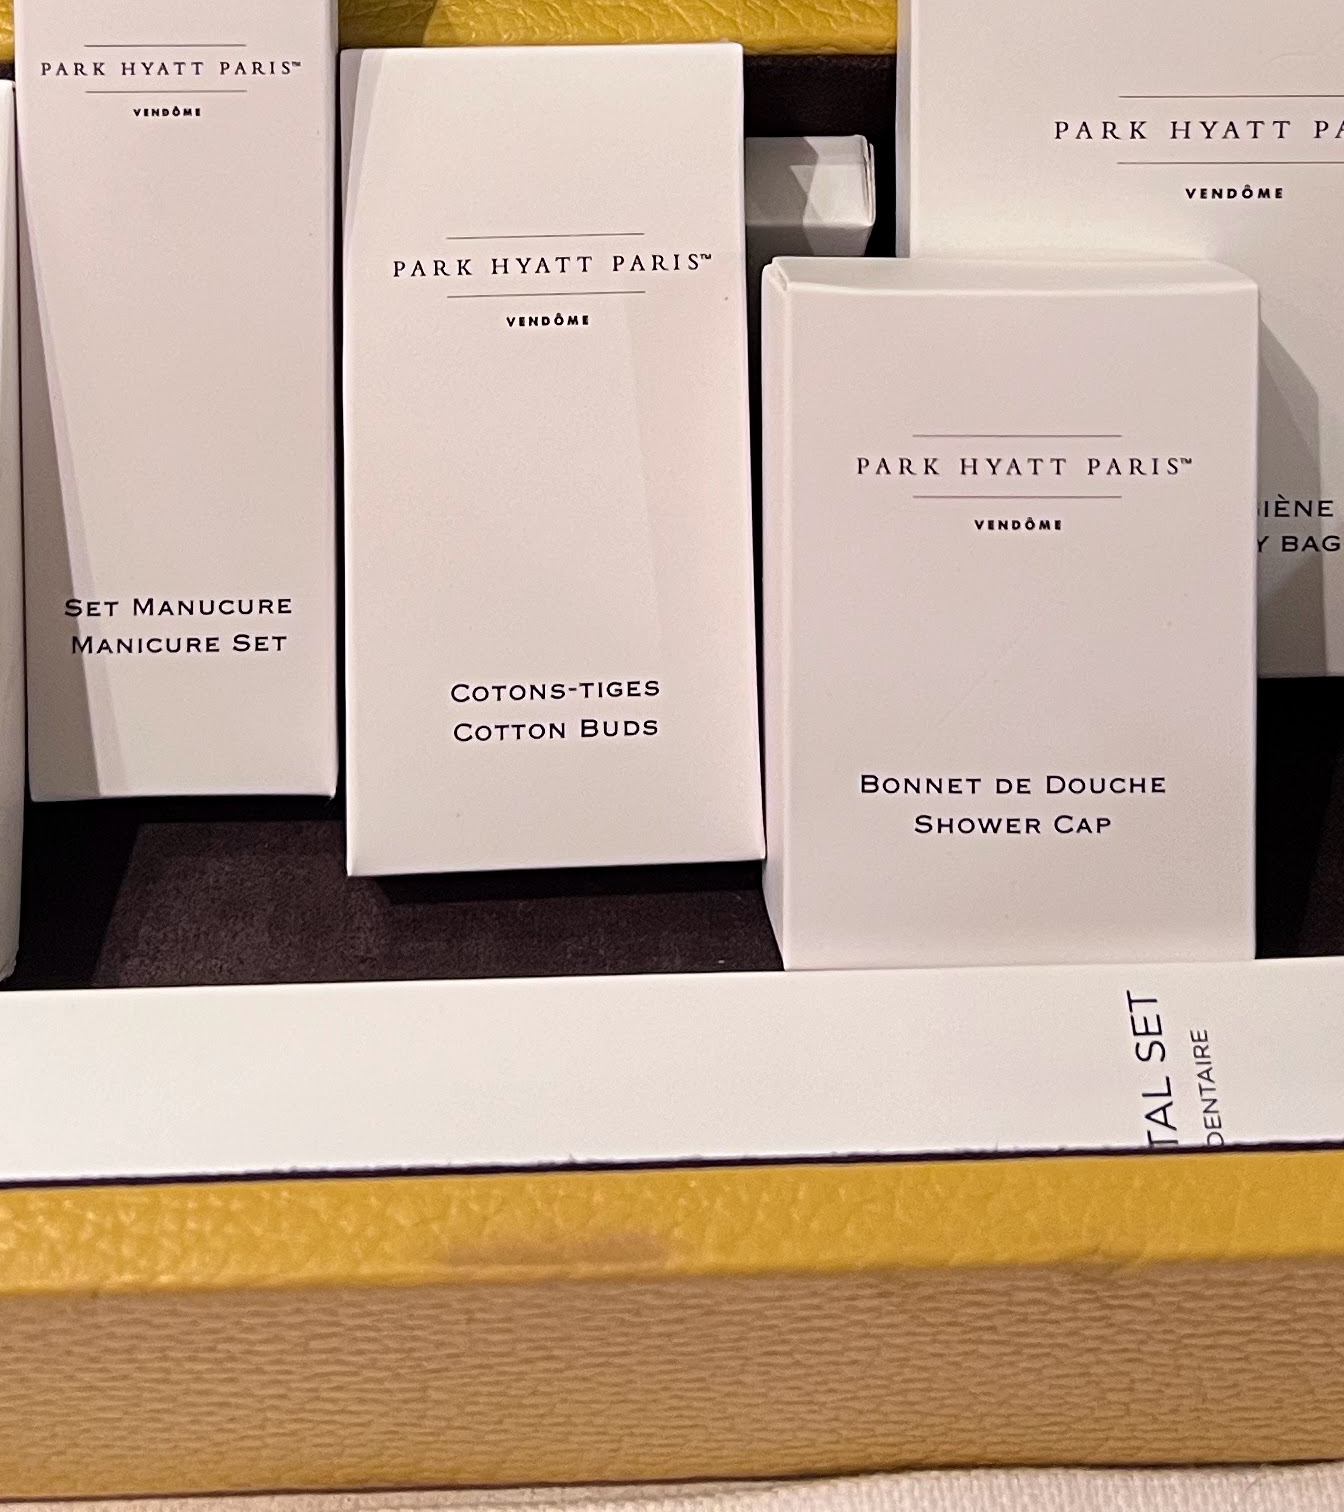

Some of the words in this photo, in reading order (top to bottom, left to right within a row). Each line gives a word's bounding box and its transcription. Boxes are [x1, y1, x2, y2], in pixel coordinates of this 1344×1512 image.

[40, 61, 106, 77] PARK
[120, 61, 205, 76] HYATT
[132, 105, 201, 118] VENDÔME
[1054, 120, 1148, 140] PARK
[1169, 120, 1291, 140] HYATT
[1184, 183, 1284, 200] VENDÔME
[392, 258, 473, 278] PARK
[491, 255, 593, 275] HYATT
[505, 312, 589, 328] VENDÔME
[857, 457, 940, 476] PARK
[959, 457, 1067, 477] HYATT
[1257, 493, 1333, 517] IÈNE
[973, 516, 1062, 531] VENDÔME
[1281, 535, 1341, 553] BAG
[1127, 990, 1166, 1062] SET
[1191, 1029, 1225, 1147] DENTAIRE
